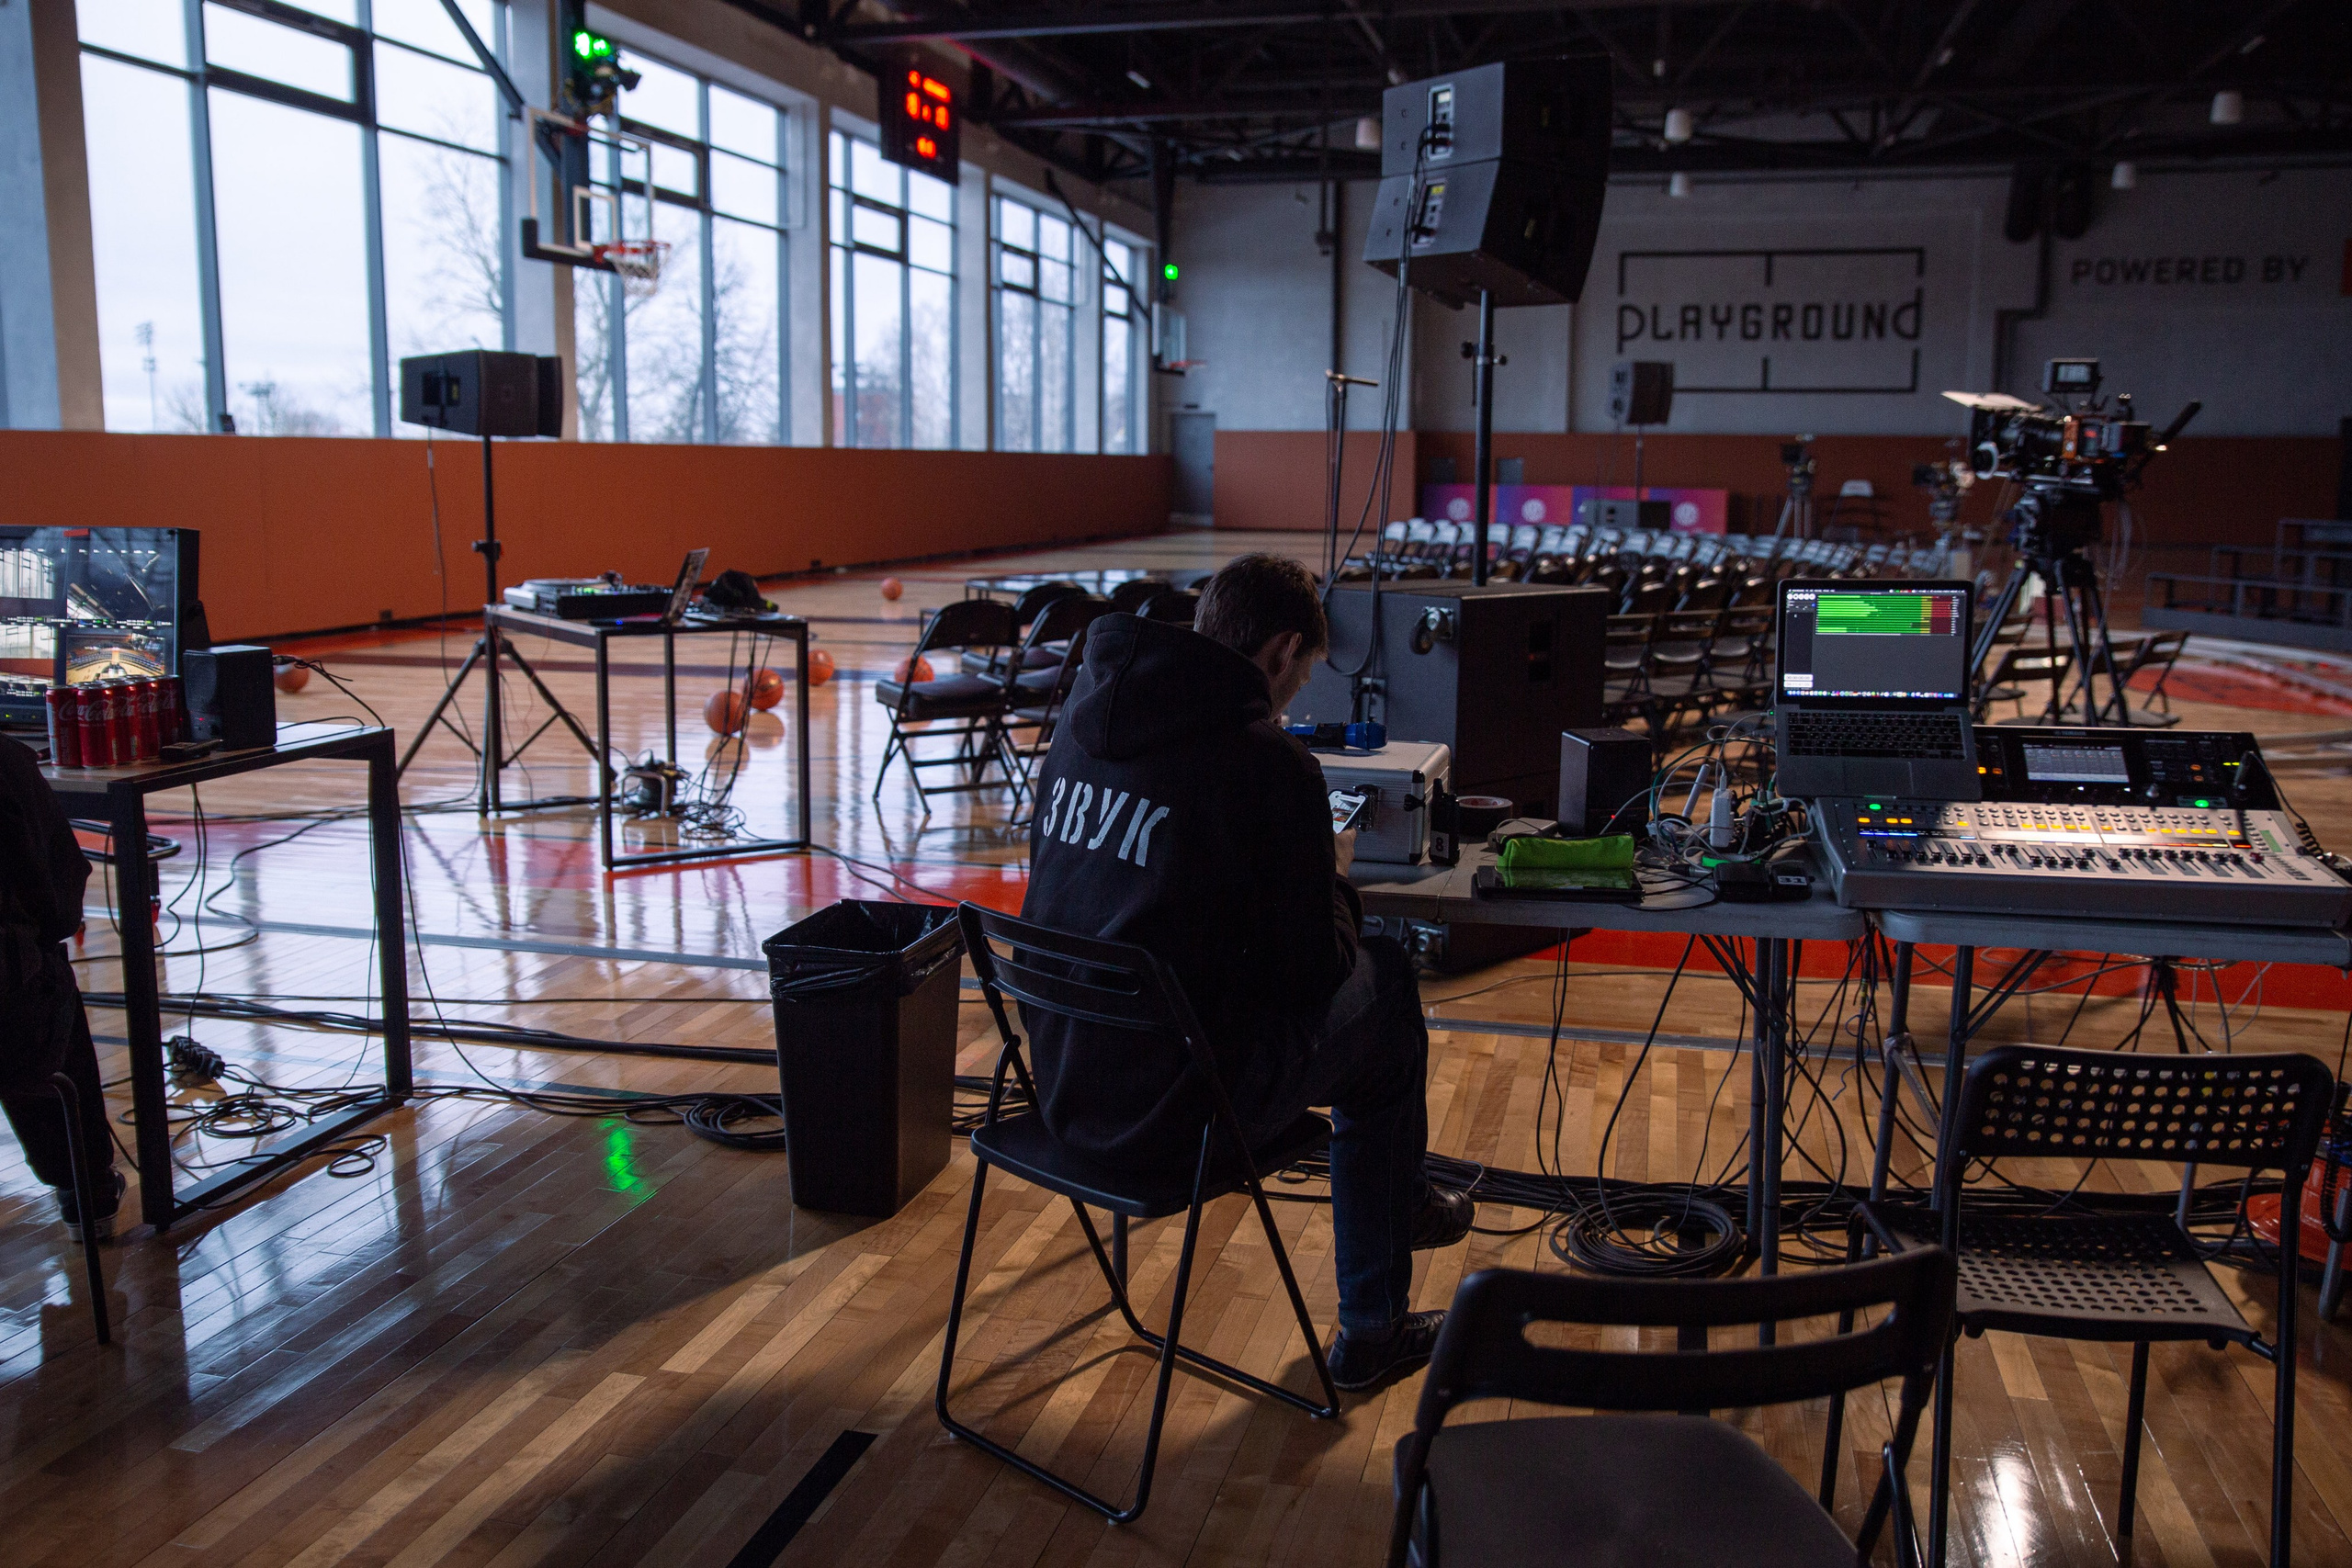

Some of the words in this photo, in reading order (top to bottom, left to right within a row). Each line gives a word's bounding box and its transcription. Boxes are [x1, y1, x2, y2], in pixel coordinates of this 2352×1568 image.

[2071, 256, 2245, 285] POWERED
[2262, 254, 2310, 283] BY
[1043, 777, 1170, 867] ЗВУК
[1435, 837, 1444, 852] 8
